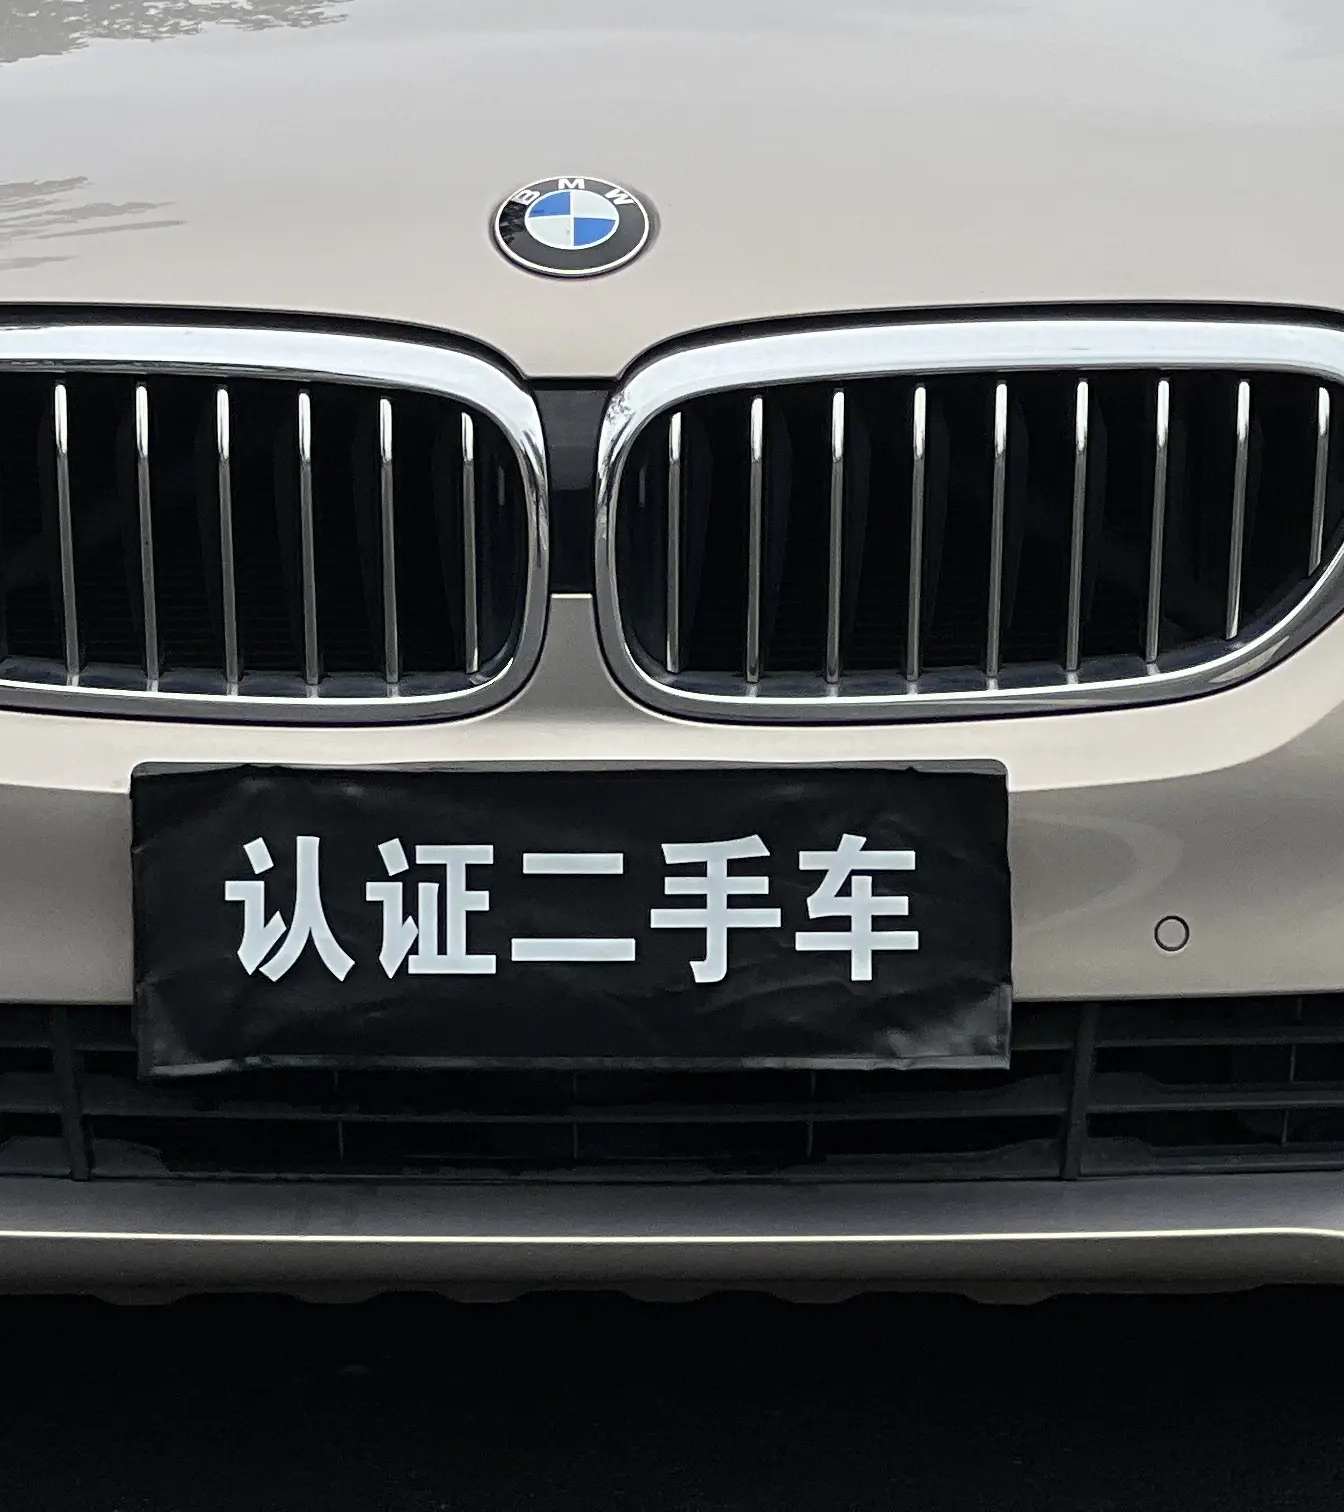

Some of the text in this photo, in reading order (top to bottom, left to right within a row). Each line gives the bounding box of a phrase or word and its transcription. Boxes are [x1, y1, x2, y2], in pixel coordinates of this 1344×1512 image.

[510, 178, 635, 206] BMW
[225, 833, 920, 984] 认证二手车
